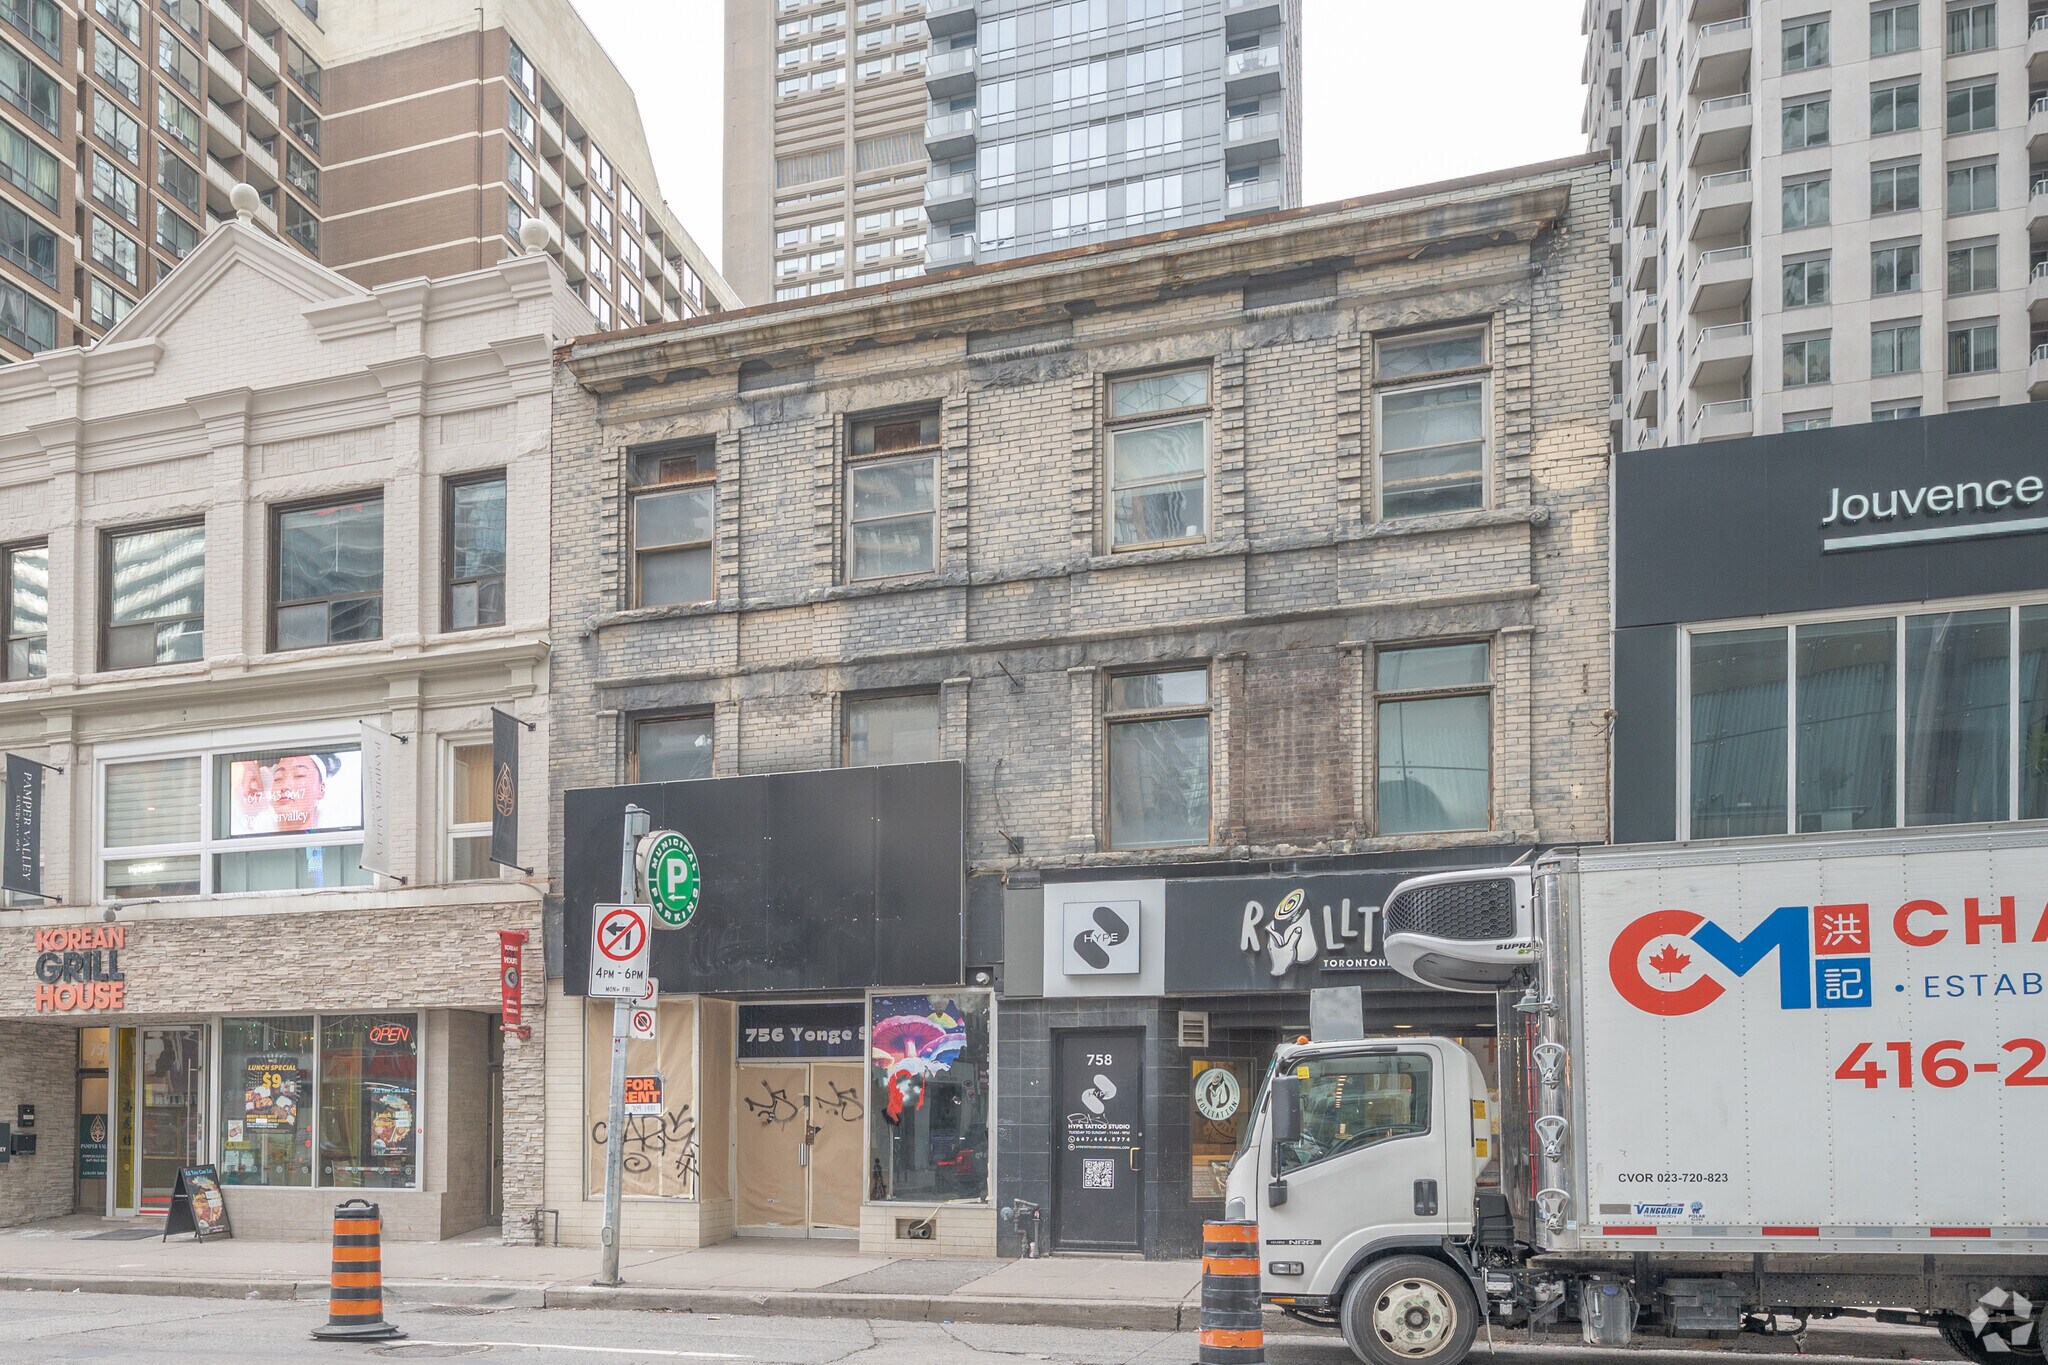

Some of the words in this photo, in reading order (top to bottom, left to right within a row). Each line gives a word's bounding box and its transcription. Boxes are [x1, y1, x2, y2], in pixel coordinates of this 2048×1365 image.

[1822, 475, 2045, 524] Jouvence
[22, 772, 32, 826] PAMPER
[22, 830, 32, 880] VALLEY
[651, 838, 697, 872] MUNICIPAL
[666, 858, 688, 893] P
[651, 887, 699, 922] PARKING
[35, 926, 125, 952] KOREAN
[1084, 932, 1118, 943] HYPE
[1496, 942, 1532, 950] SUPRA
[35, 950, 125, 983] GRILL
[1323, 959, 1390, 967] TORONTON
[1822, 912, 1864, 1000] 洪記
[595, 967, 615, 979] 4PM
[624, 968, 643, 979] 6PM
[1924, 972, 2044, 998] ESTAB
[35, 981, 125, 1011] HOUSE
[369, 1027, 410, 1042] OPEN
[745, 1028, 784, 1042] 756
[790, 1027, 853, 1044] Yonge
[1086, 1054, 1112, 1066] 758
[1835, 1038, 2048, 1089] 416-2
[262, 1072, 282, 1089] $9
[625, 1079, 655, 1091] FOR
[1618, 1173, 1654, 1183] CVOR
[1657, 1173, 1729, 1183] 023-720-823
[1634, 1203, 1684, 1214] VANGUARD
